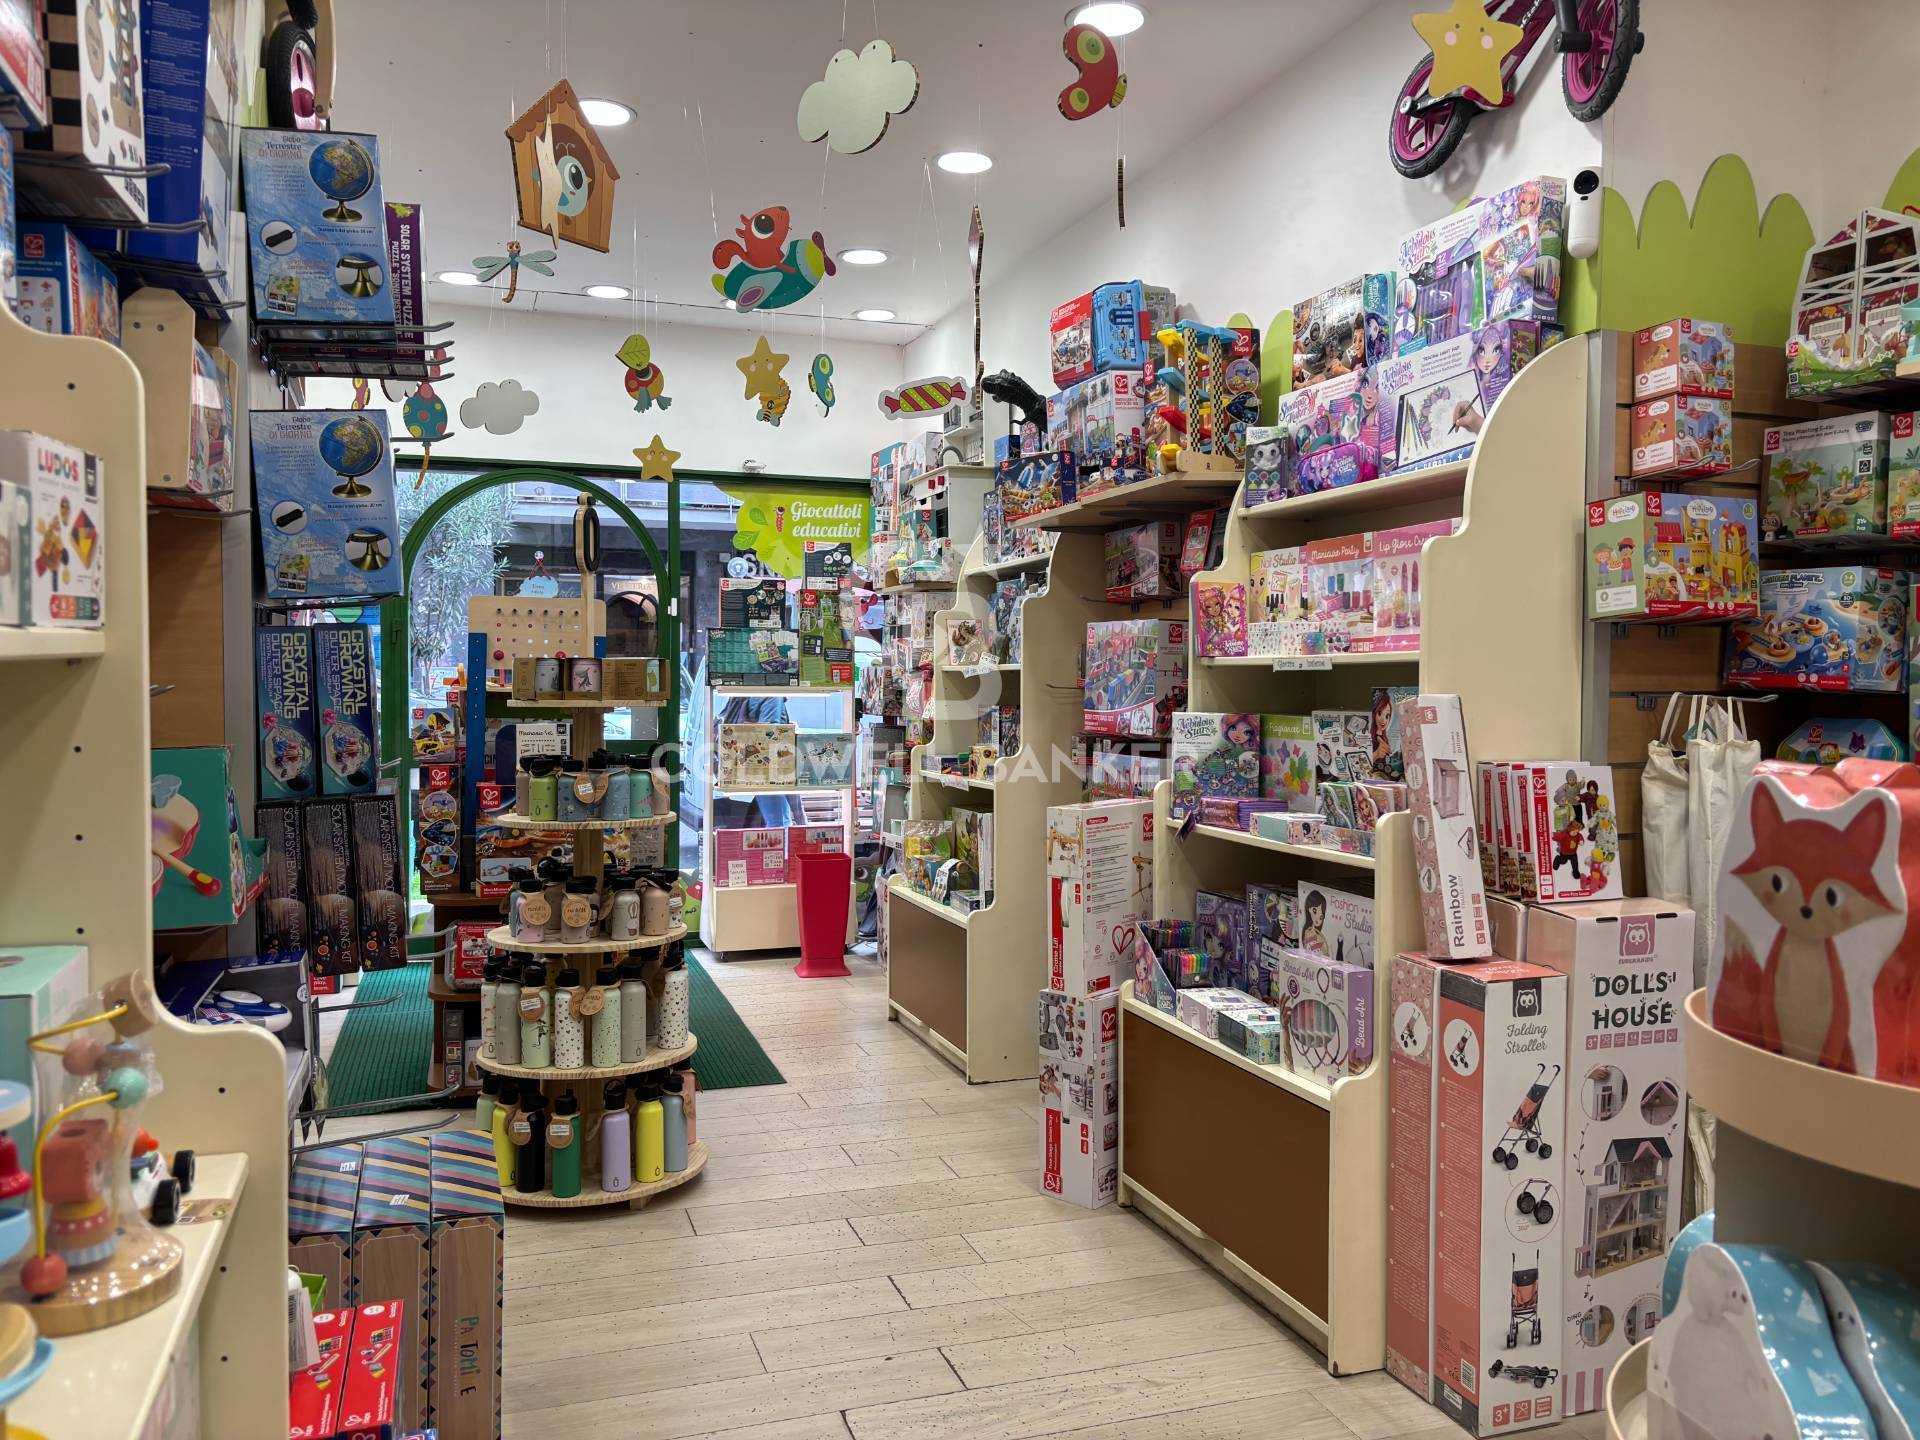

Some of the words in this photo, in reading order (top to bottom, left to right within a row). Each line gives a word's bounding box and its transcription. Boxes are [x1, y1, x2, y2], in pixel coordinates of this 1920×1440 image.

[265, 142, 302, 150] Terrestre
[269, 150, 303, 159] GIORNO
[401, 224, 410, 251] SOLAR
[401, 253, 412, 296] SYSTEM
[403, 300, 414, 339] PUZZE
[274, 423, 312, 431] Terrestre
[38, 448, 79, 482] LUDOS
[791, 501, 863, 521] Giocattoli
[792, 522, 862, 538] educativi
[1312, 549, 1341, 560] Manicure
[1341, 545, 1360, 558] Party
[1379, 542, 1391, 553] Lip
[1392, 540, 1413, 551] Gloss
[1272, 552, 1298, 569] Studio
[272, 633, 281, 674] OUTER
[330, 630, 339, 672] OUTER
[281, 633, 296, 719] GROWING
[294, 632, 309, 719] CRYSTAL
[339, 630, 355, 715] GROWING
[352, 630, 368, 715] CRYSTAL
[273, 677, 283, 718] SPACE
[332, 674, 342, 713] SPACE
[1176, 716, 1215, 731] Nebulous
[1184, 726, 1212, 740] Stars
[431, 779, 448, 787] Hape
[283, 807, 295, 840] SOLAR
[331, 804, 343, 837] SOLAR
[379, 800, 391, 833] SOLAR
[285, 840, 298, 878] SYSTEM
[333, 837, 346, 878] SYSTEM
[381, 833, 393, 872] SYSTEM
[1330, 896, 1359, 914] Fashion
[1448, 874, 1465, 948] Rainbow
[339, 909, 351, 949] MAKING
[386, 903, 399, 944] MAKING
[1344, 914, 1373, 935] Studio
[342, 951, 352, 963] KIT
[389, 946, 400, 959] KIT
[1282, 959, 1300, 976] Bead
[1301, 968, 1315, 981] Art
[1356, 997, 1366, 1017] Art
[1592, 1003, 1673, 1030] HOUSE
[1102, 1029, 1116, 1039] Hape
[1355, 1020, 1366, 1049] Bead
[1507, 1023, 1548, 1038] Folding
[1505, 1039, 1547, 1055] Stroller
[1566, 1311, 1582, 1322] DING
[1575, 1315, 1593, 1326] DONG
[1495, 1407, 1509, 1424] 3+
